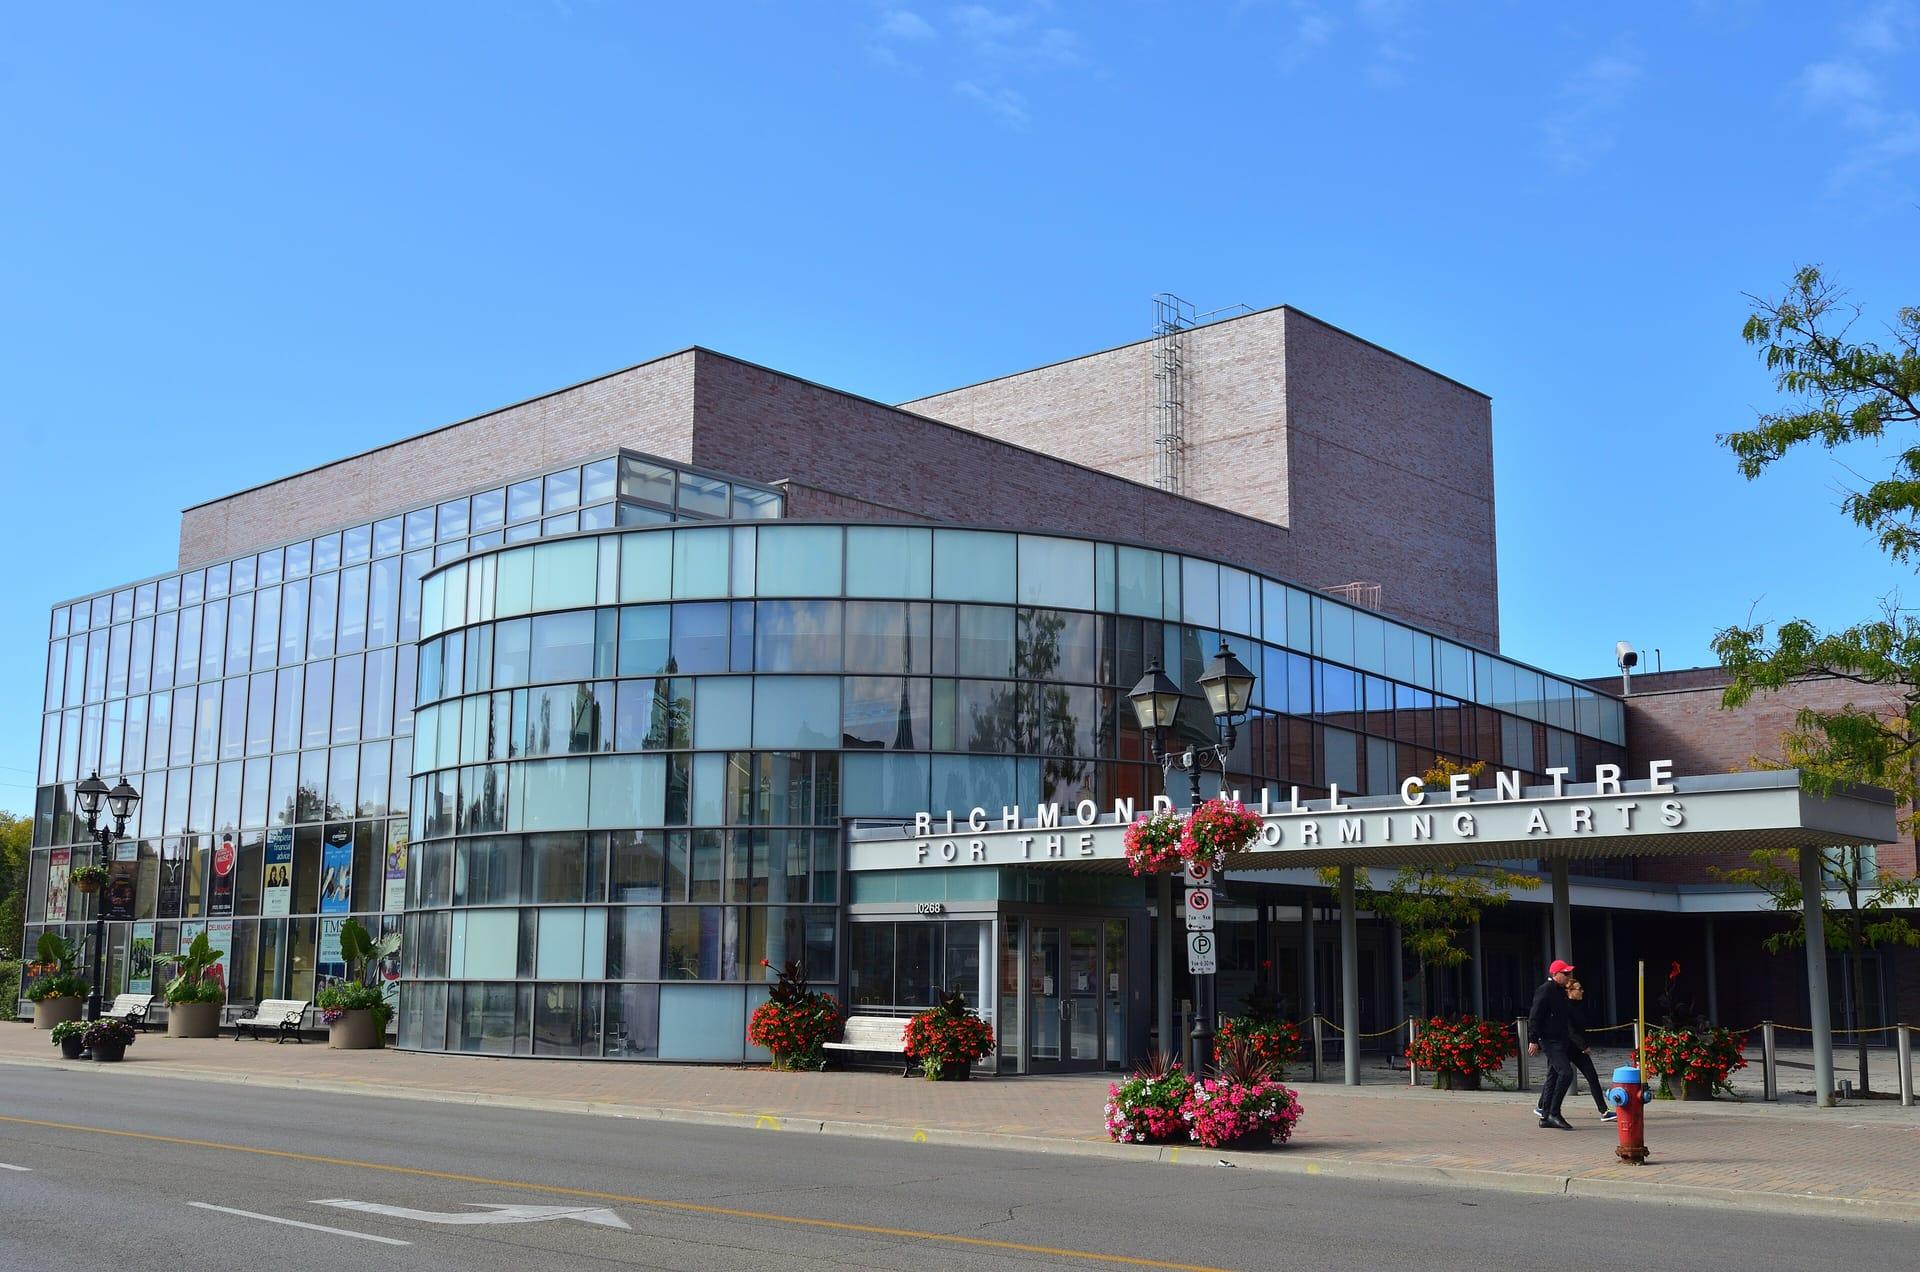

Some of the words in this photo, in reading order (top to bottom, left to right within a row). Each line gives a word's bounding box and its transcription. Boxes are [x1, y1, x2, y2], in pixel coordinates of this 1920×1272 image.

[915, 795, 1172, 836] RICHMOND
[1401, 760, 1674, 806] CENTRE
[918, 840, 986, 864] FOR
[1017, 834, 1094, 859] THE
[1263, 811, 1476, 847] ORMING
[1527, 800, 1684, 834] ARTS
[916, 903, 942, 914] 10268
[1198, 939, 1208, 951] P
